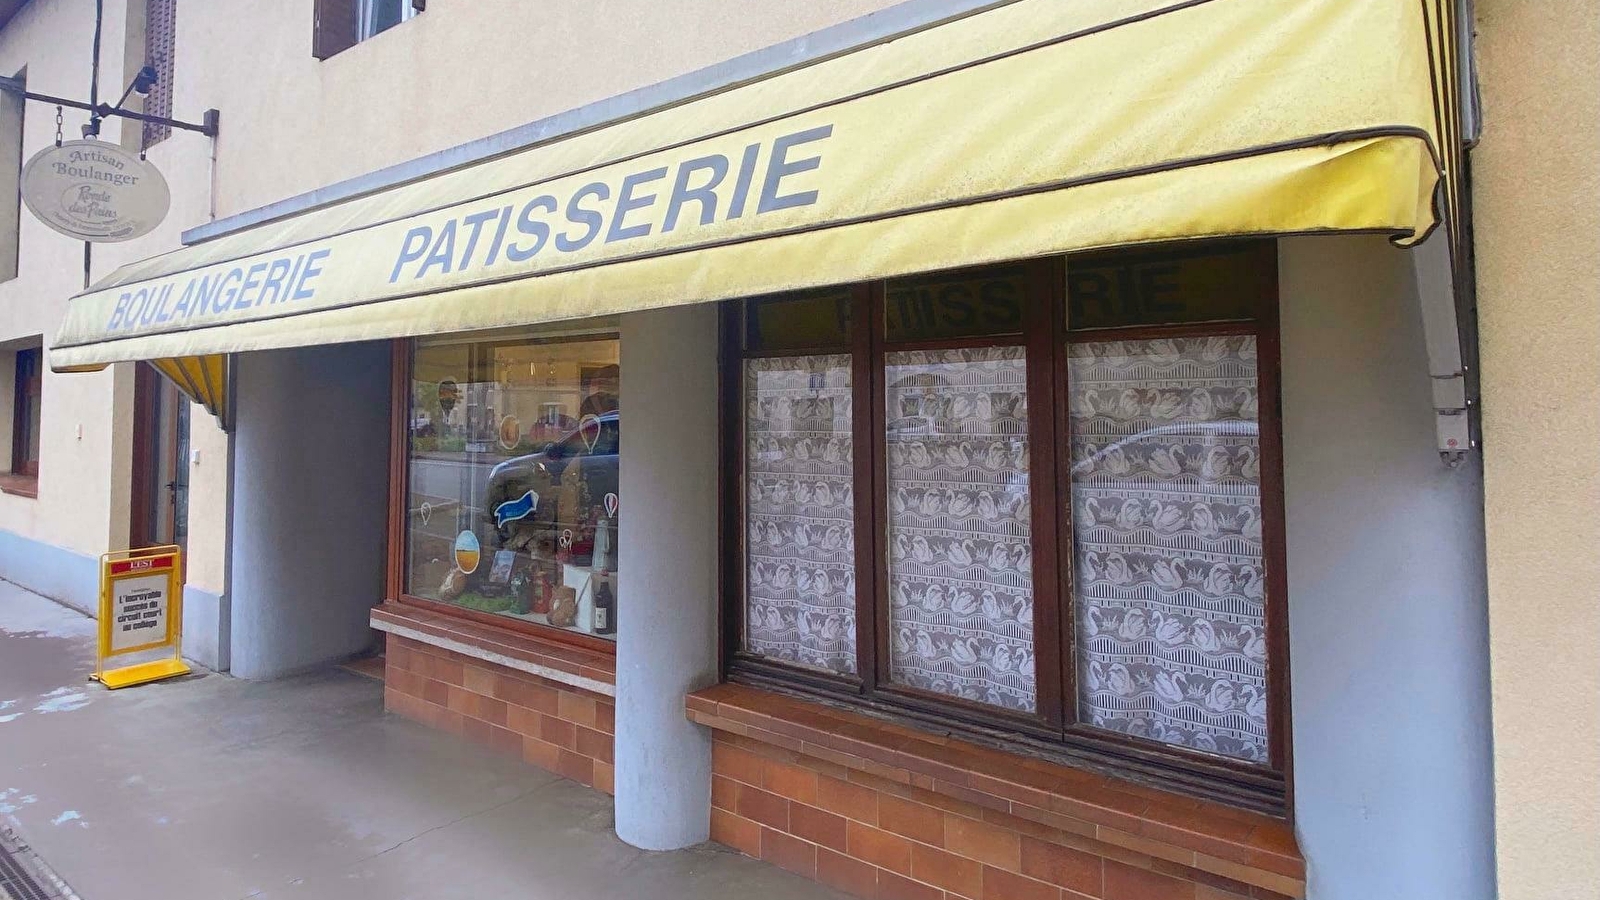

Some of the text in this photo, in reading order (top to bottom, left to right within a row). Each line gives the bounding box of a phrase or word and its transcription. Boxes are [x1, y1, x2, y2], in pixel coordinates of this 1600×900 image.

[69, 150, 125, 170] Artisan
[52, 162, 139, 186] Boulanger
[106, 123, 834, 330] BOULANGERIE PATISSERIE
